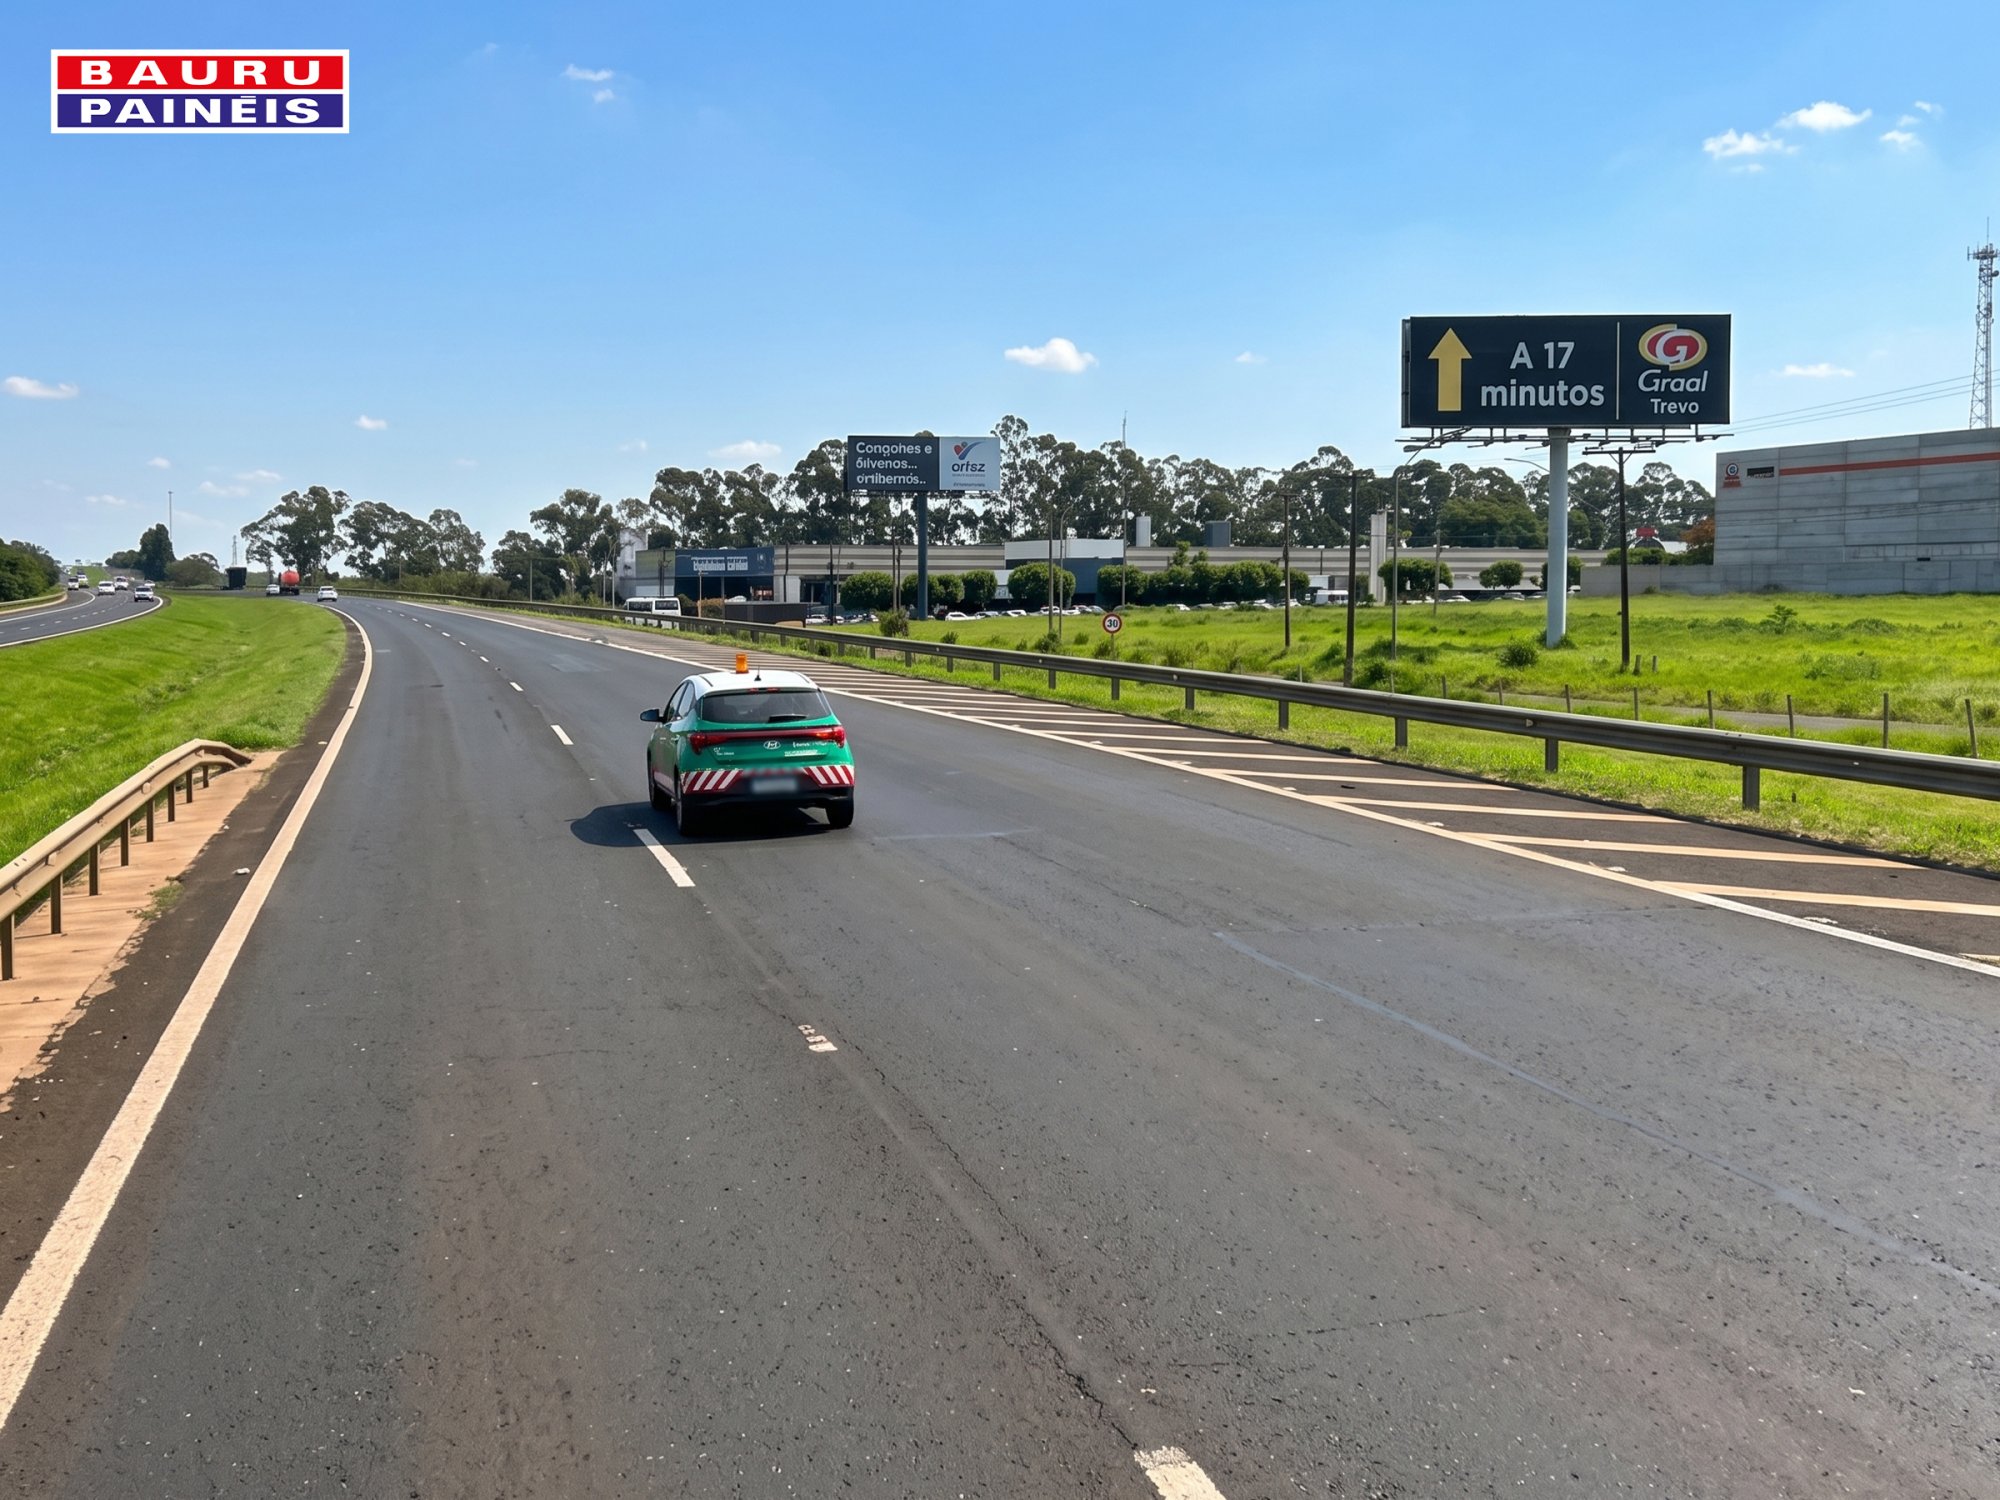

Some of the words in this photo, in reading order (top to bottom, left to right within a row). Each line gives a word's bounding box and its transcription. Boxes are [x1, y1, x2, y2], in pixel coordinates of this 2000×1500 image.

[1509, 341, 1534, 369] A
[1543, 341, 1575, 369] 17
[1638, 369, 1709, 392] Graal
[1480, 378, 1605, 407] minutos
[1650, 398, 1699, 414] Trevo
[924, 444, 933, 454] e
[1106, 619, 1119, 628] 30
